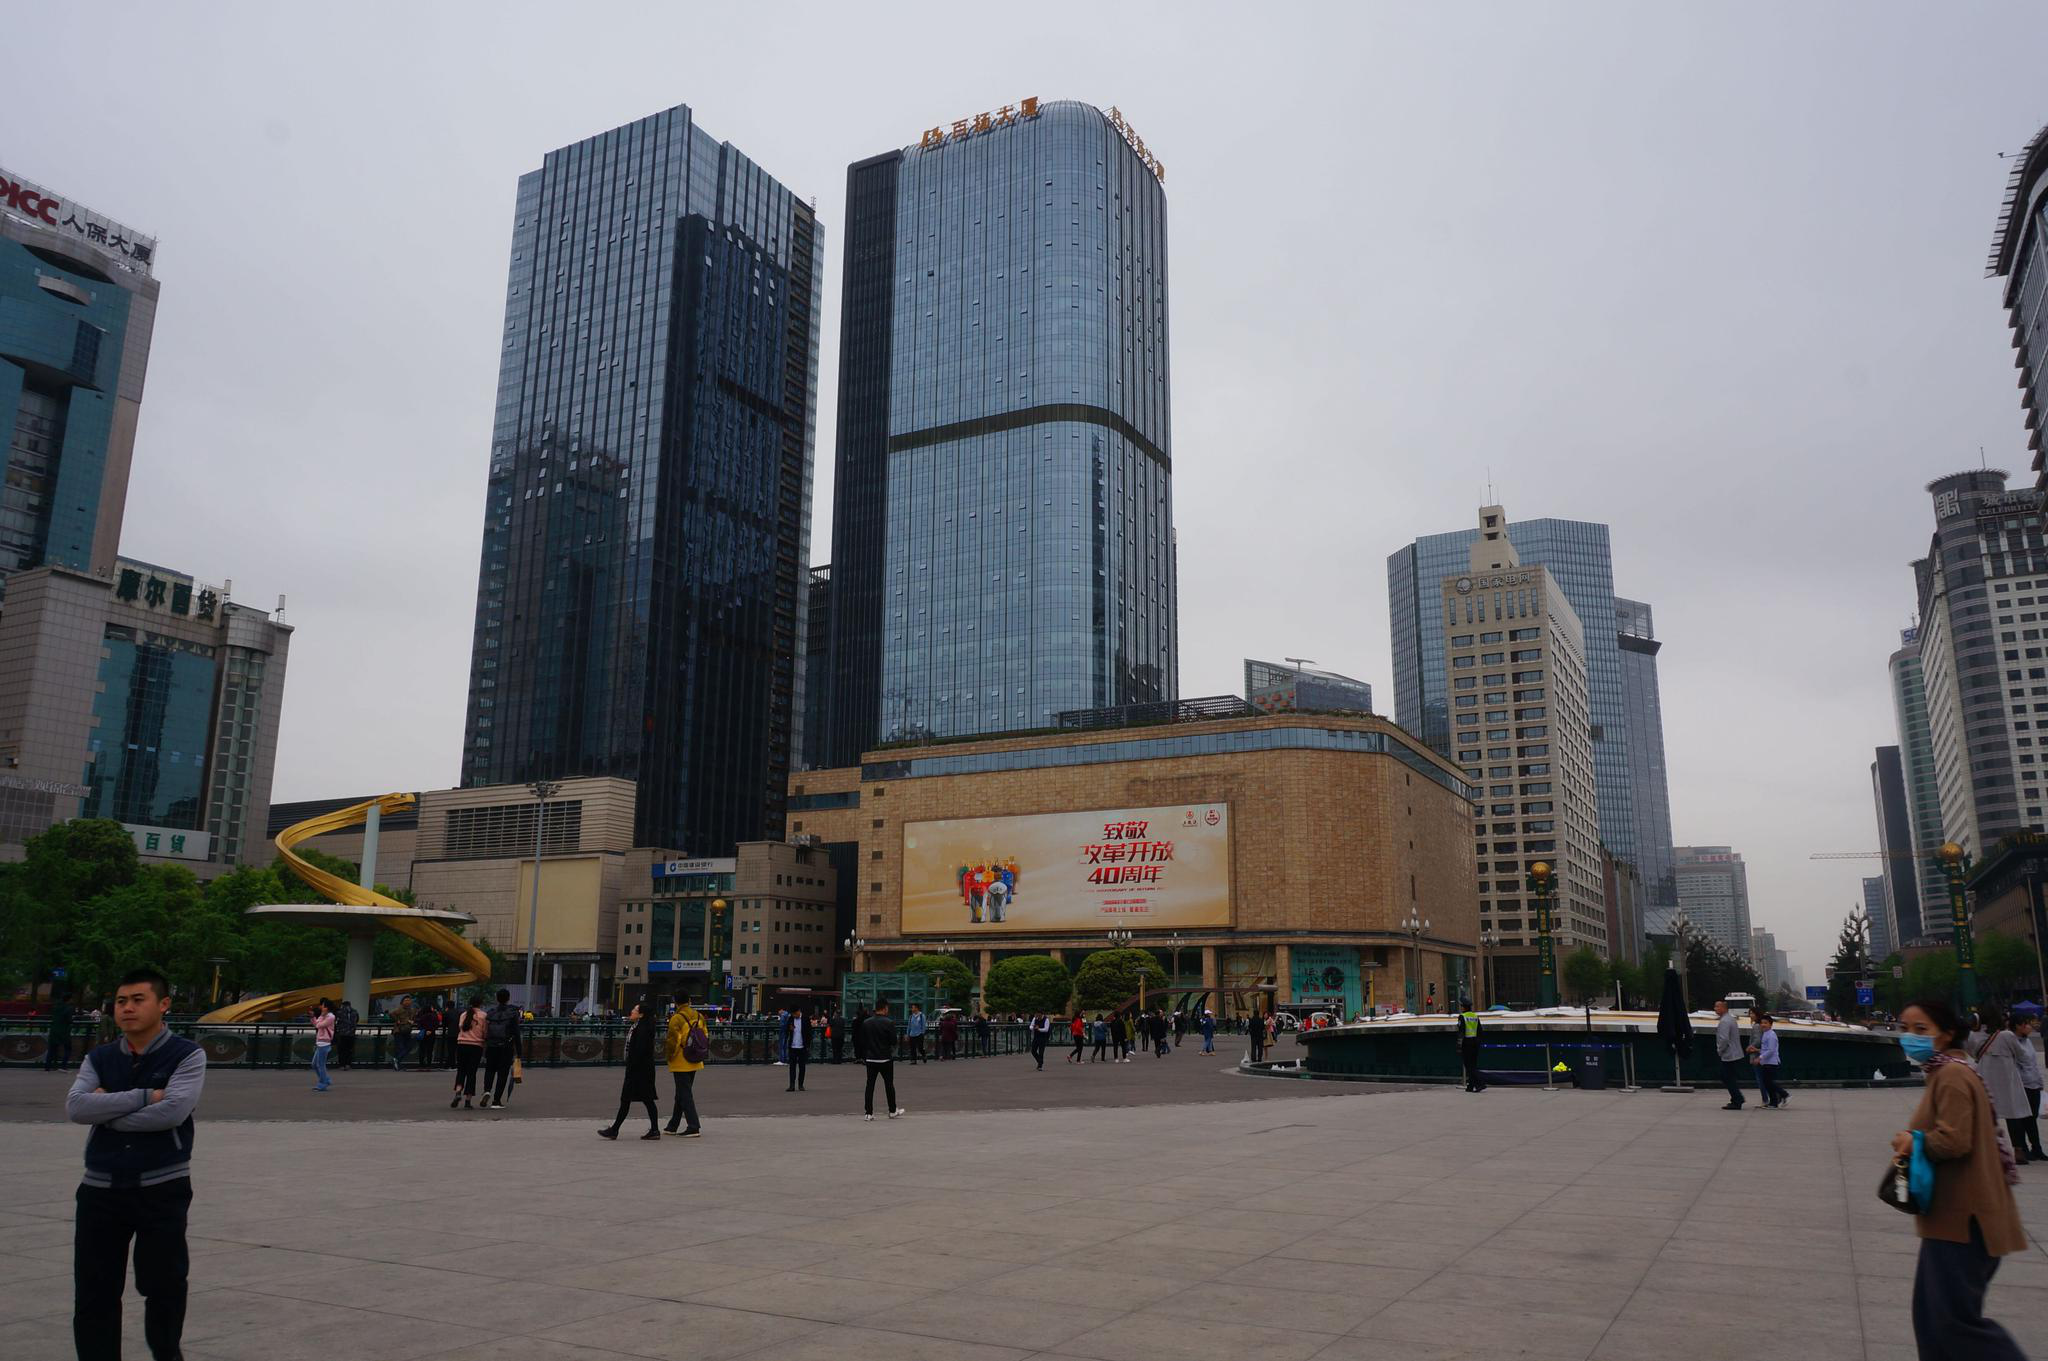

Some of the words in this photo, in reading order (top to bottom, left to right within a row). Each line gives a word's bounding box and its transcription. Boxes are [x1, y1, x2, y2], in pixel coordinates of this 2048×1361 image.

[62, 214, 151, 266] 人保大厦
[1478, 572, 1531, 590] 国家电网
[1102, 820, 1150, 841] 致敬
[1079, 840, 1176, 865] 改革开放
[1087, 865, 1167, 885] 40周年
